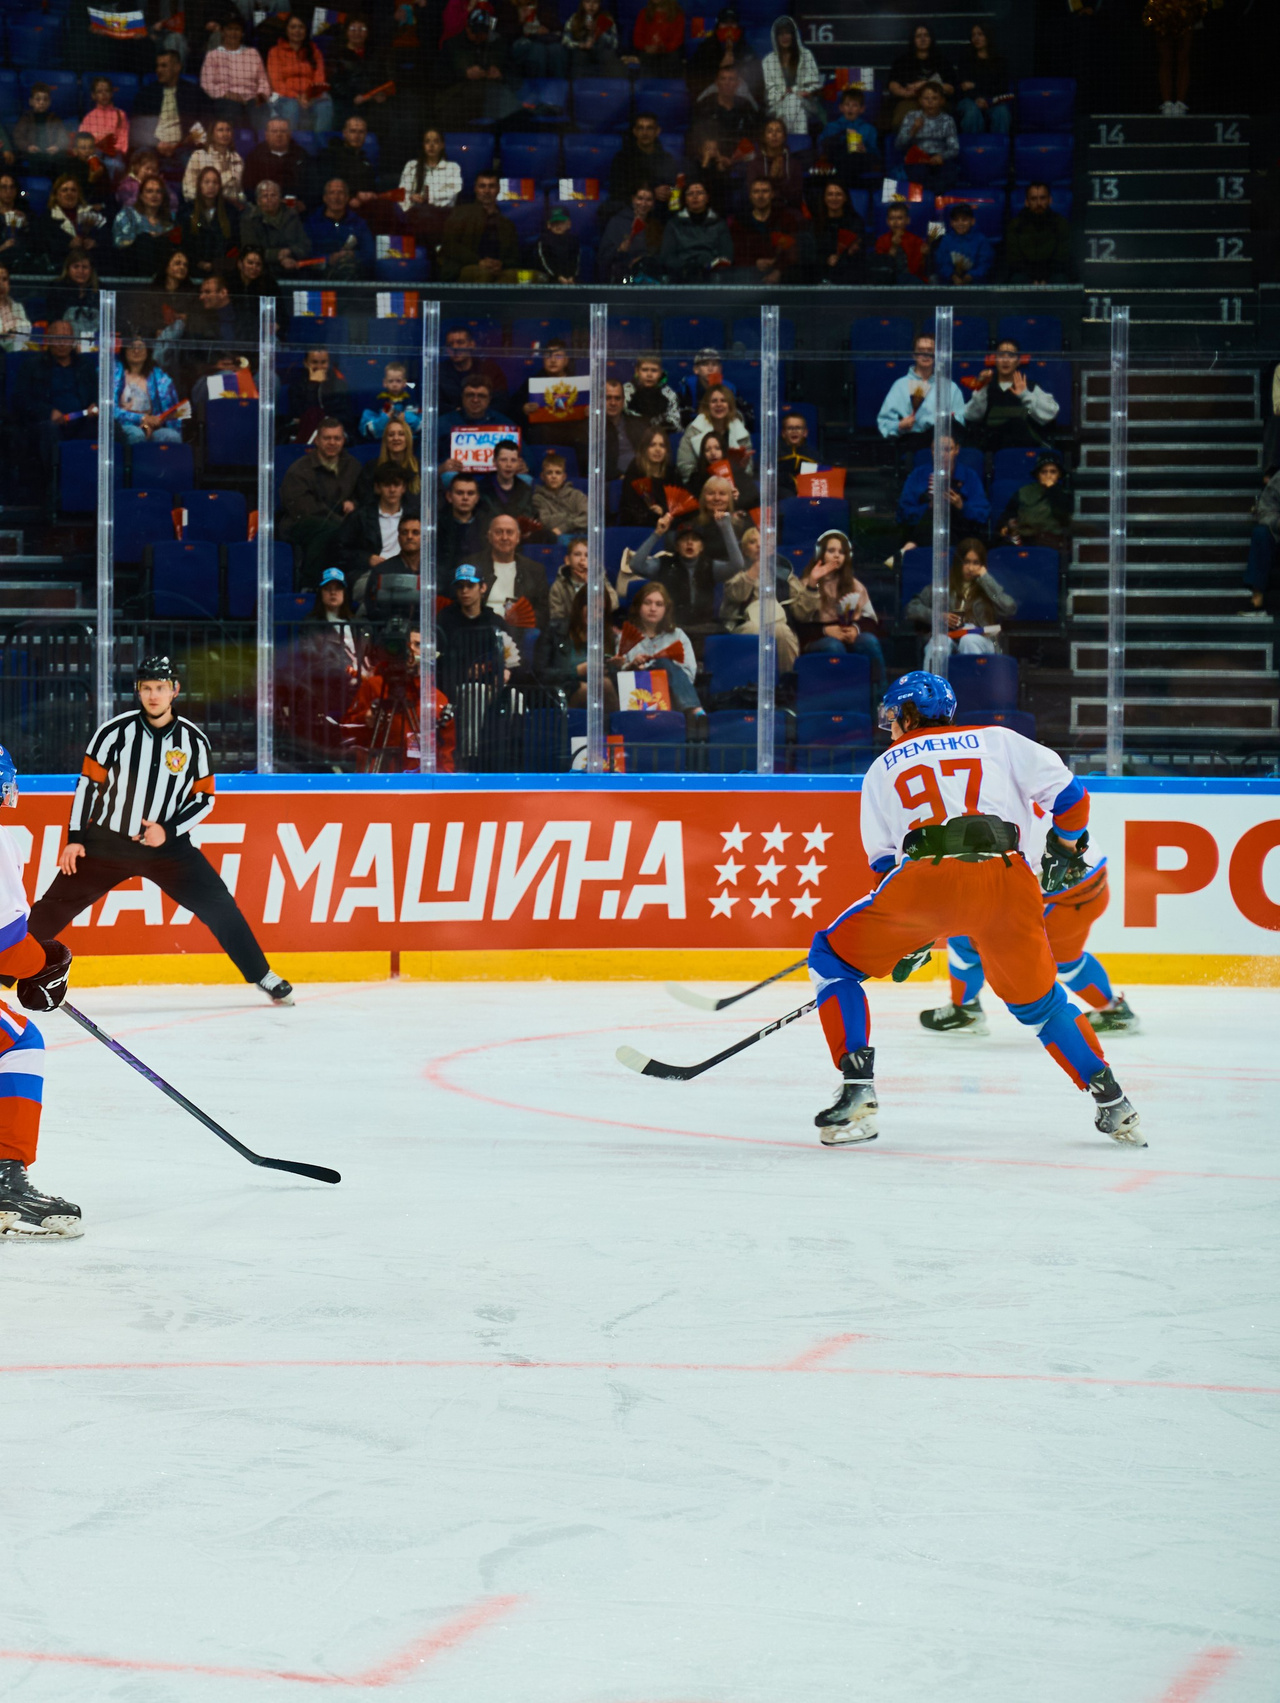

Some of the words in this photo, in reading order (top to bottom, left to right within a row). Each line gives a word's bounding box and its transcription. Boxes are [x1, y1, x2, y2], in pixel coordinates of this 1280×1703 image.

[808, 24, 835, 44] 16
[1097, 123, 1125, 146] 14
[1213, 121, 1241, 144] 14
[1091, 177, 1120, 200] 13
[1216, 176, 1245, 200] 13
[1087, 237, 1117, 261] 12
[1216, 236, 1244, 260] 12
[1220, 296, 1242, 323] 11
[454, 447, 494, 462] ВПЕР
[883, 734, 980, 771] ЕРЕМЕНКО
[893, 757, 984, 831] 97
[262, 820, 687, 924] МАШИНА
